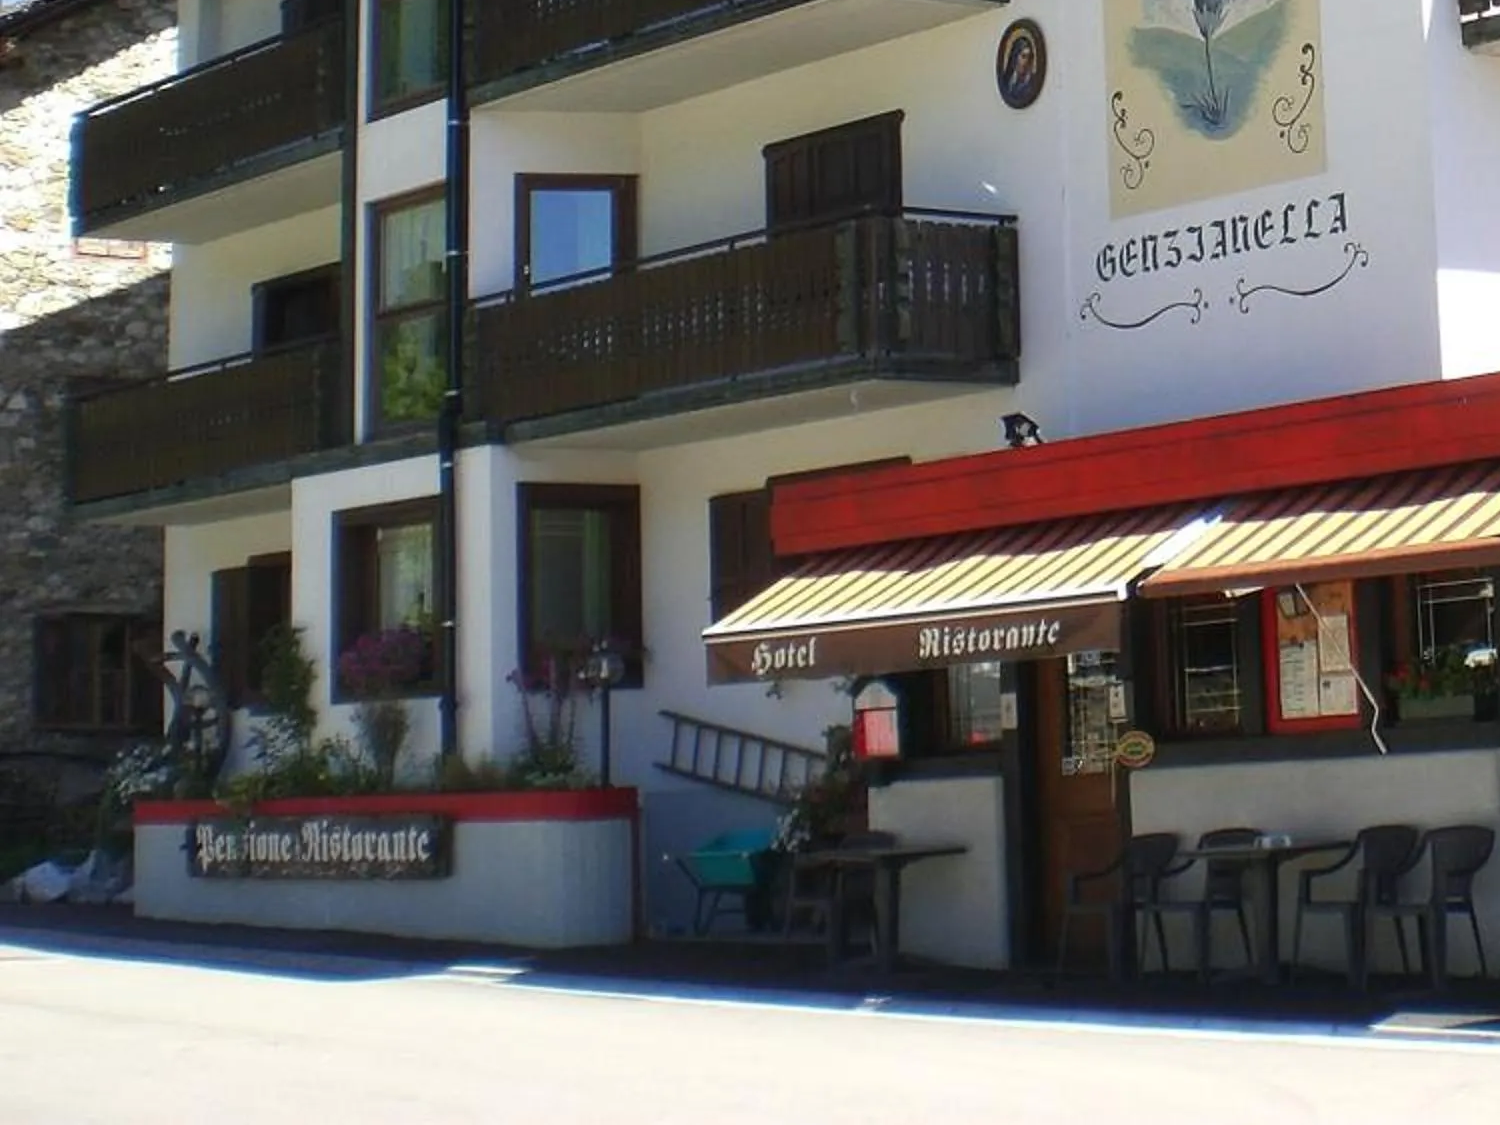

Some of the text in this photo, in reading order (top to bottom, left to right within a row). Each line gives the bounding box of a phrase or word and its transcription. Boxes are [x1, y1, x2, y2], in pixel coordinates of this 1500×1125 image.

[1096, 192, 1349, 282] GENZIANELLA
[751, 618, 1061, 676] Hotel Ristorante
[301, 820, 431, 863] Ristorante
